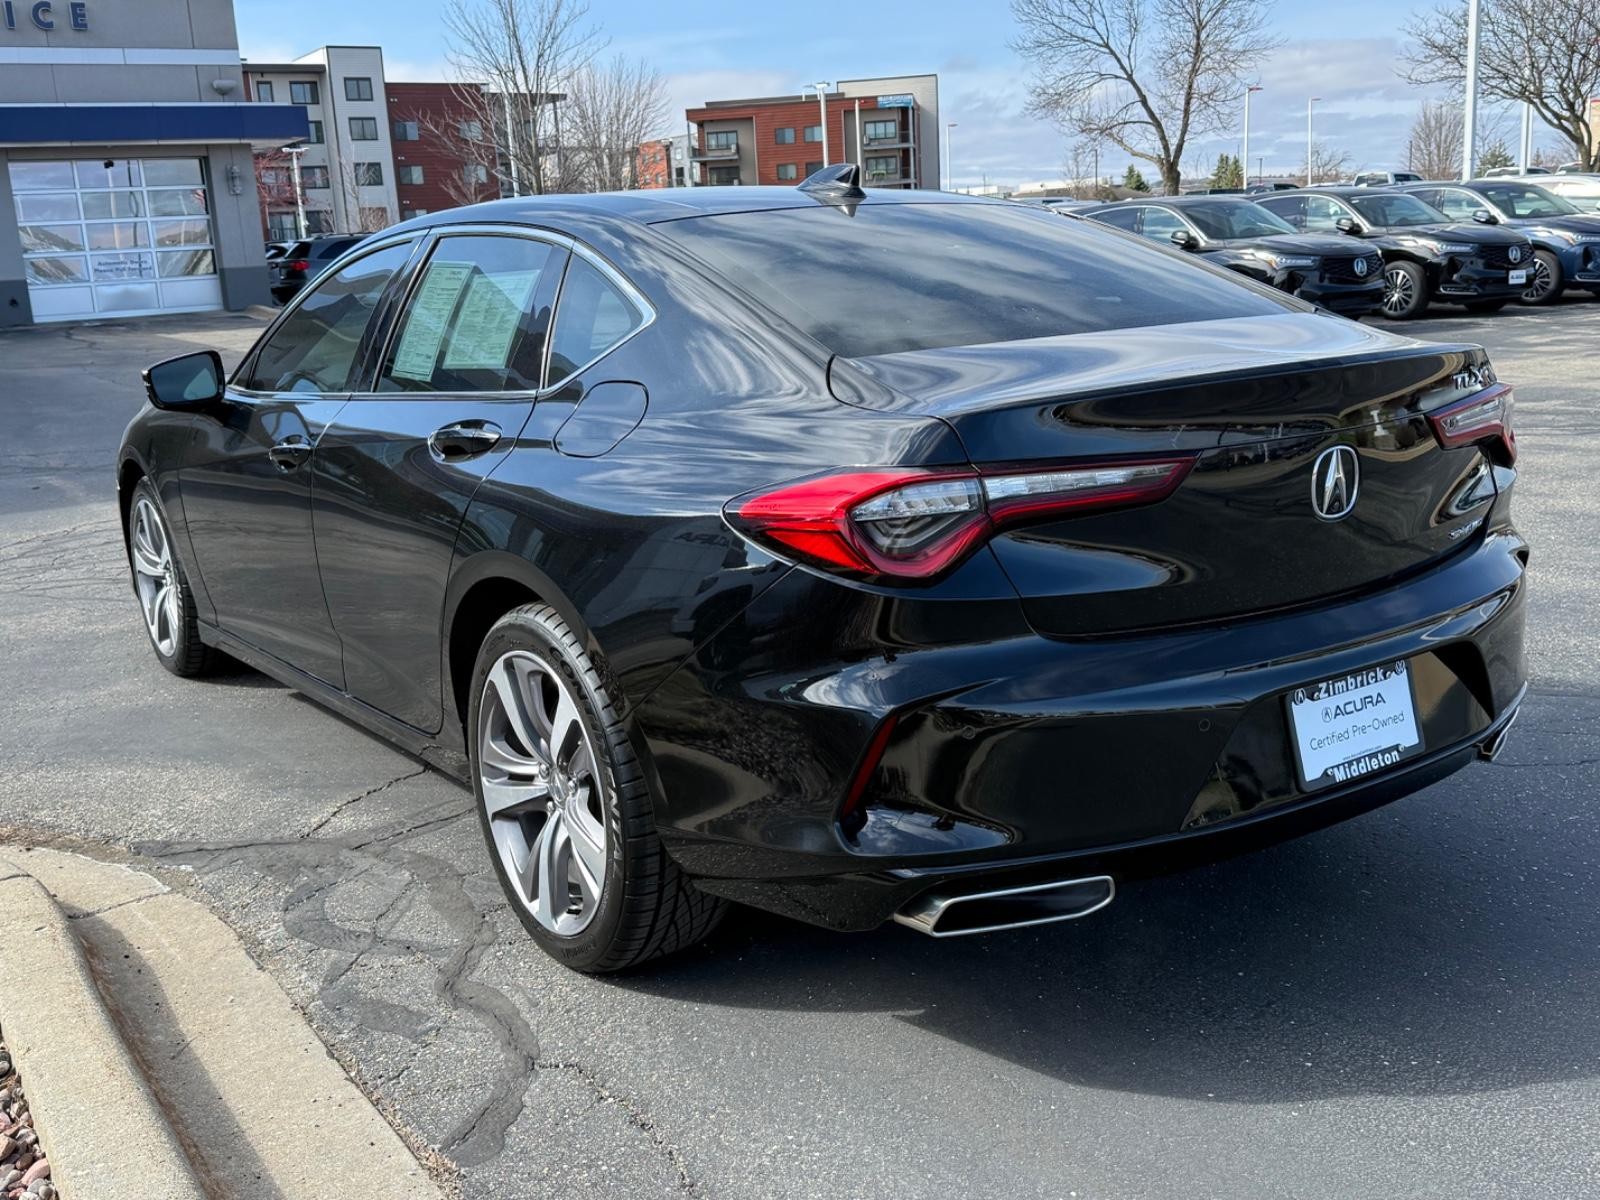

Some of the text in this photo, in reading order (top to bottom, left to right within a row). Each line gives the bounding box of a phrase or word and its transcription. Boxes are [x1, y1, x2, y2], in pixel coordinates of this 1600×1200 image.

[1318, 667, 1384, 699] Zimbrick
[1333, 692, 1386, 719] ACURA
[1309, 712, 1405, 751] Certified Pre-Owned
[1333, 750, 1400, 783] Middleton
